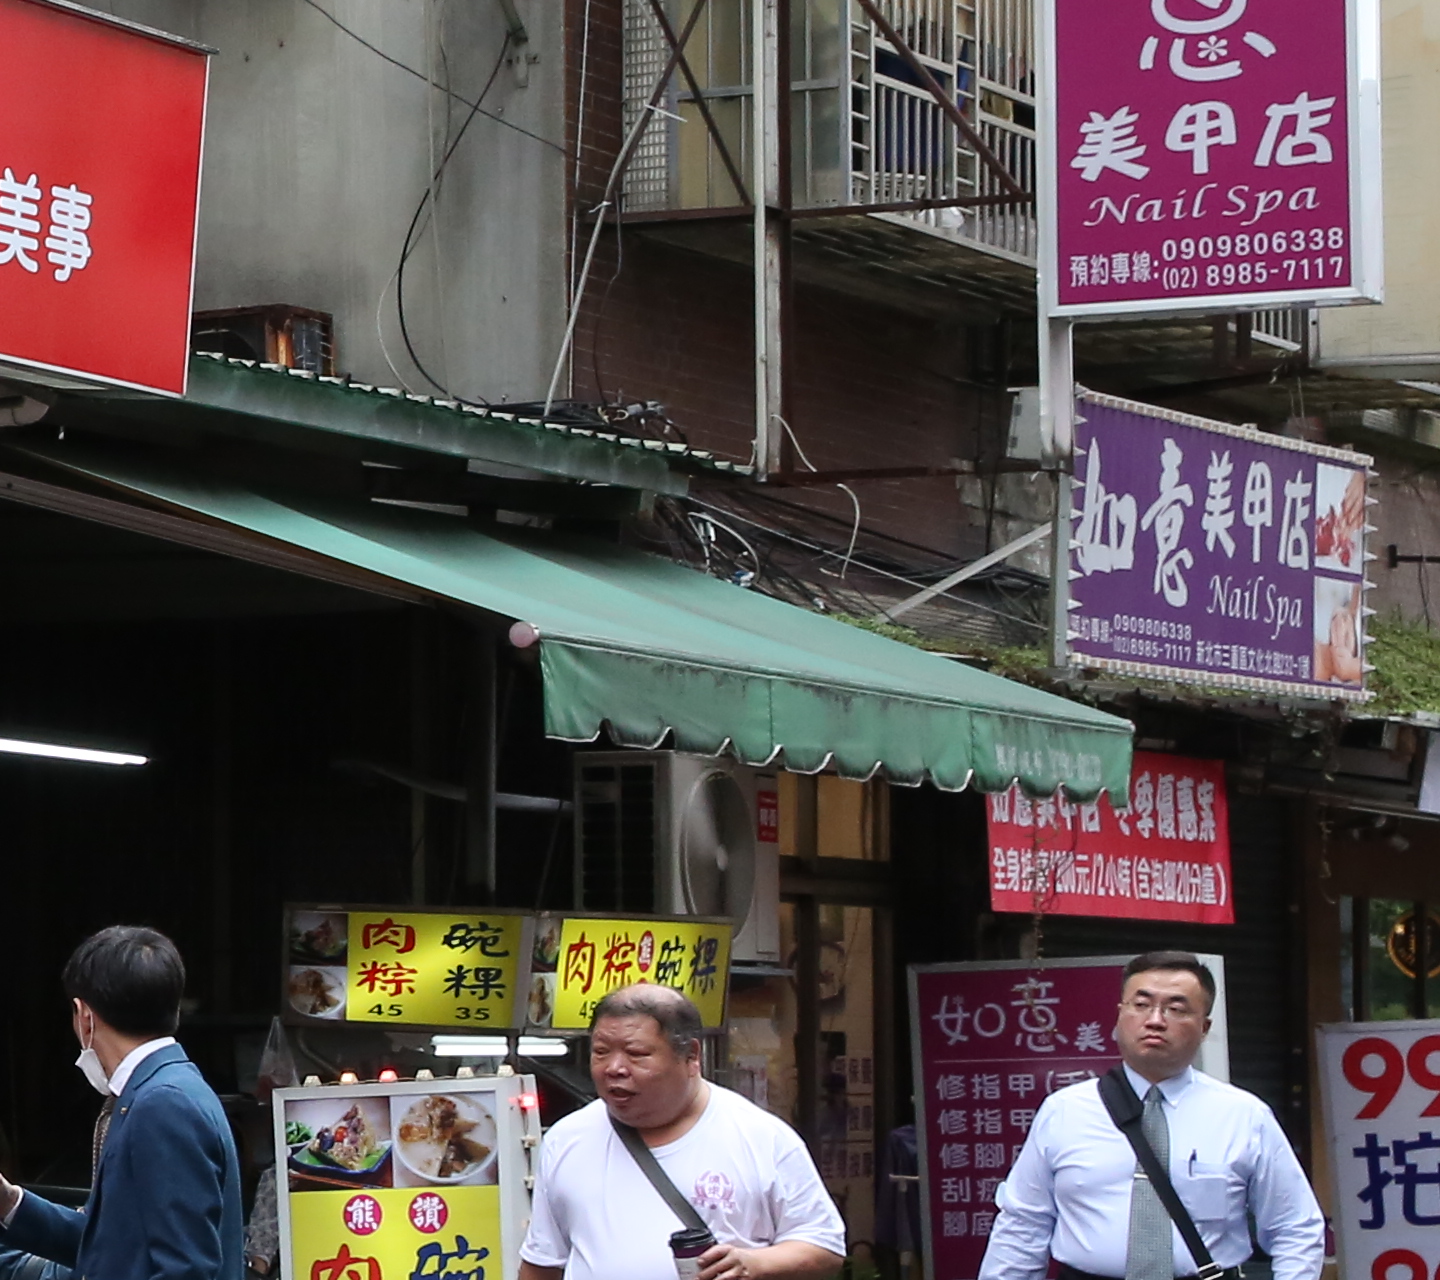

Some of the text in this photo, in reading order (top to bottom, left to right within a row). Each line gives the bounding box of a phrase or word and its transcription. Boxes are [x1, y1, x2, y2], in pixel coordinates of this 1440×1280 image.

[1069, 91, 1337, 184] 美甲店
[1082, 183, 1320, 227] Nail Spa
[1161, 226, 1345, 262] 0909806338
[1069, 250, 1344, 290] 預約專線: (02) 8985-7117
[1200, 449, 1313, 571] 美甲店
[1113, 613, 1192, 640] 0909806338
[1206, 574, 1304, 640] Nail Spa
[356, 917, 510, 1001] 肉粽 碗粿
[563, 929, 636, 995] 肉粽
[654, 934, 718, 995] 碗粿
[367, 1002, 491, 1021] 45 35
[938, 1142, 1023, 1170] 修腳
[347, 1195, 445, 1232] 熊 讚
